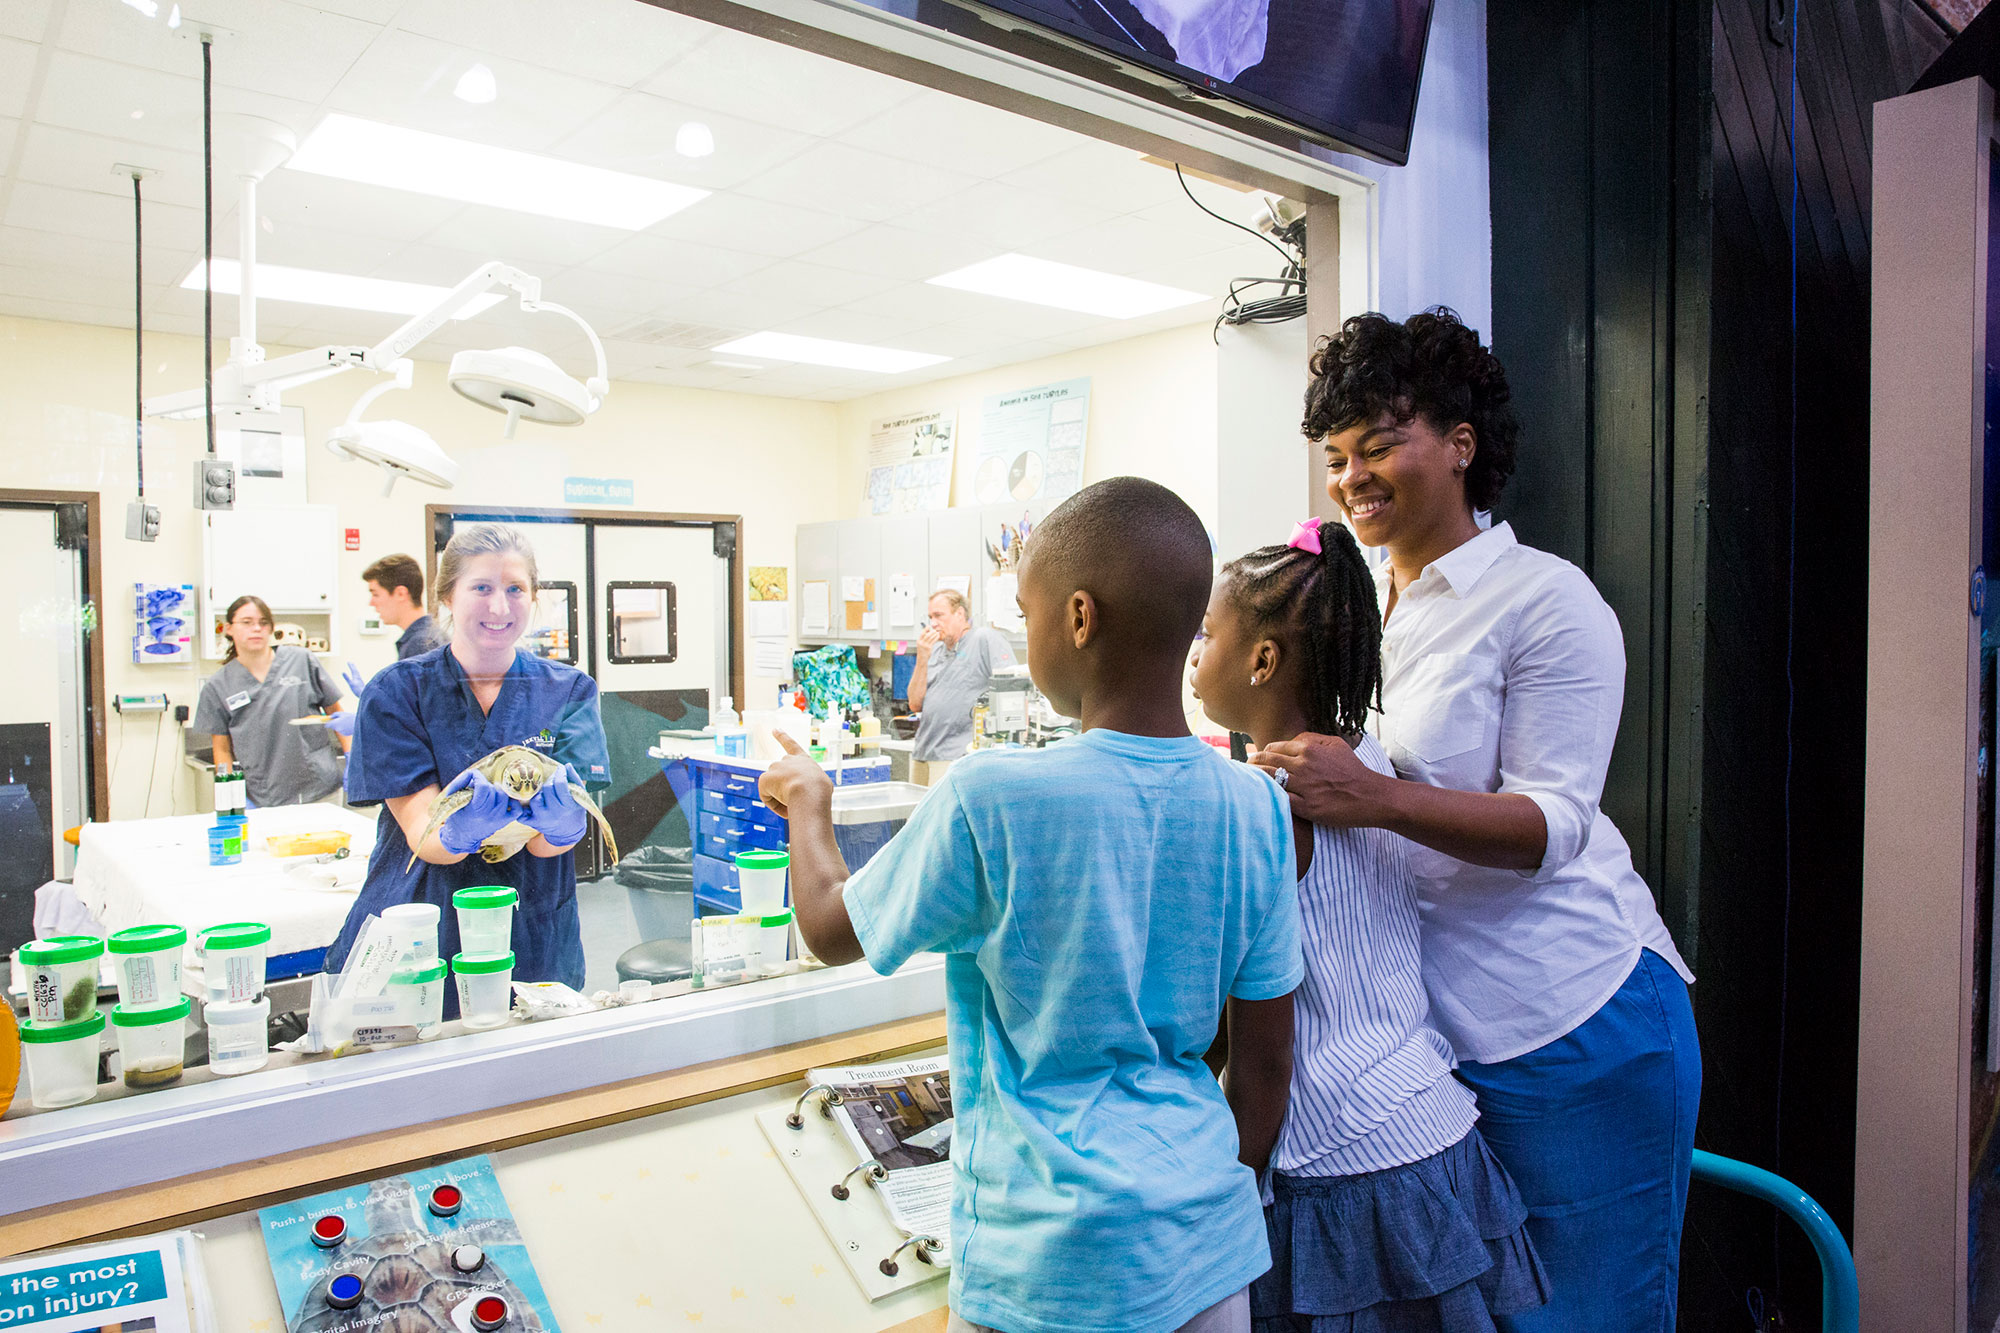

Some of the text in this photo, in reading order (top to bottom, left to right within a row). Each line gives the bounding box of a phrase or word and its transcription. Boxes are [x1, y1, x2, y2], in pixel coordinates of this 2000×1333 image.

[1209, 81, 1217, 89] LG
[846, 1062, 939, 1081] Treatment Room
[270, 1216, 296, 1230] Push
[307, 1205, 344, 1219] button
[345, 1202, 357, 1210] to
[359, 1194, 386, 1207] view
[417, 1182, 431, 1192] on
[432, 1177, 447, 1187] TV
[426, 1228, 457, 1243] Turtle
[458, 1219, 497, 1235] Release
[11, 1258, 137, 1295] the most
[300, 1256, 370, 1281] Body Cavity
[44, 1281, 139, 1315] injury?
[446, 1277, 507, 1302] GPS Tracker
[351, 1309, 398, 1330] Imagery
